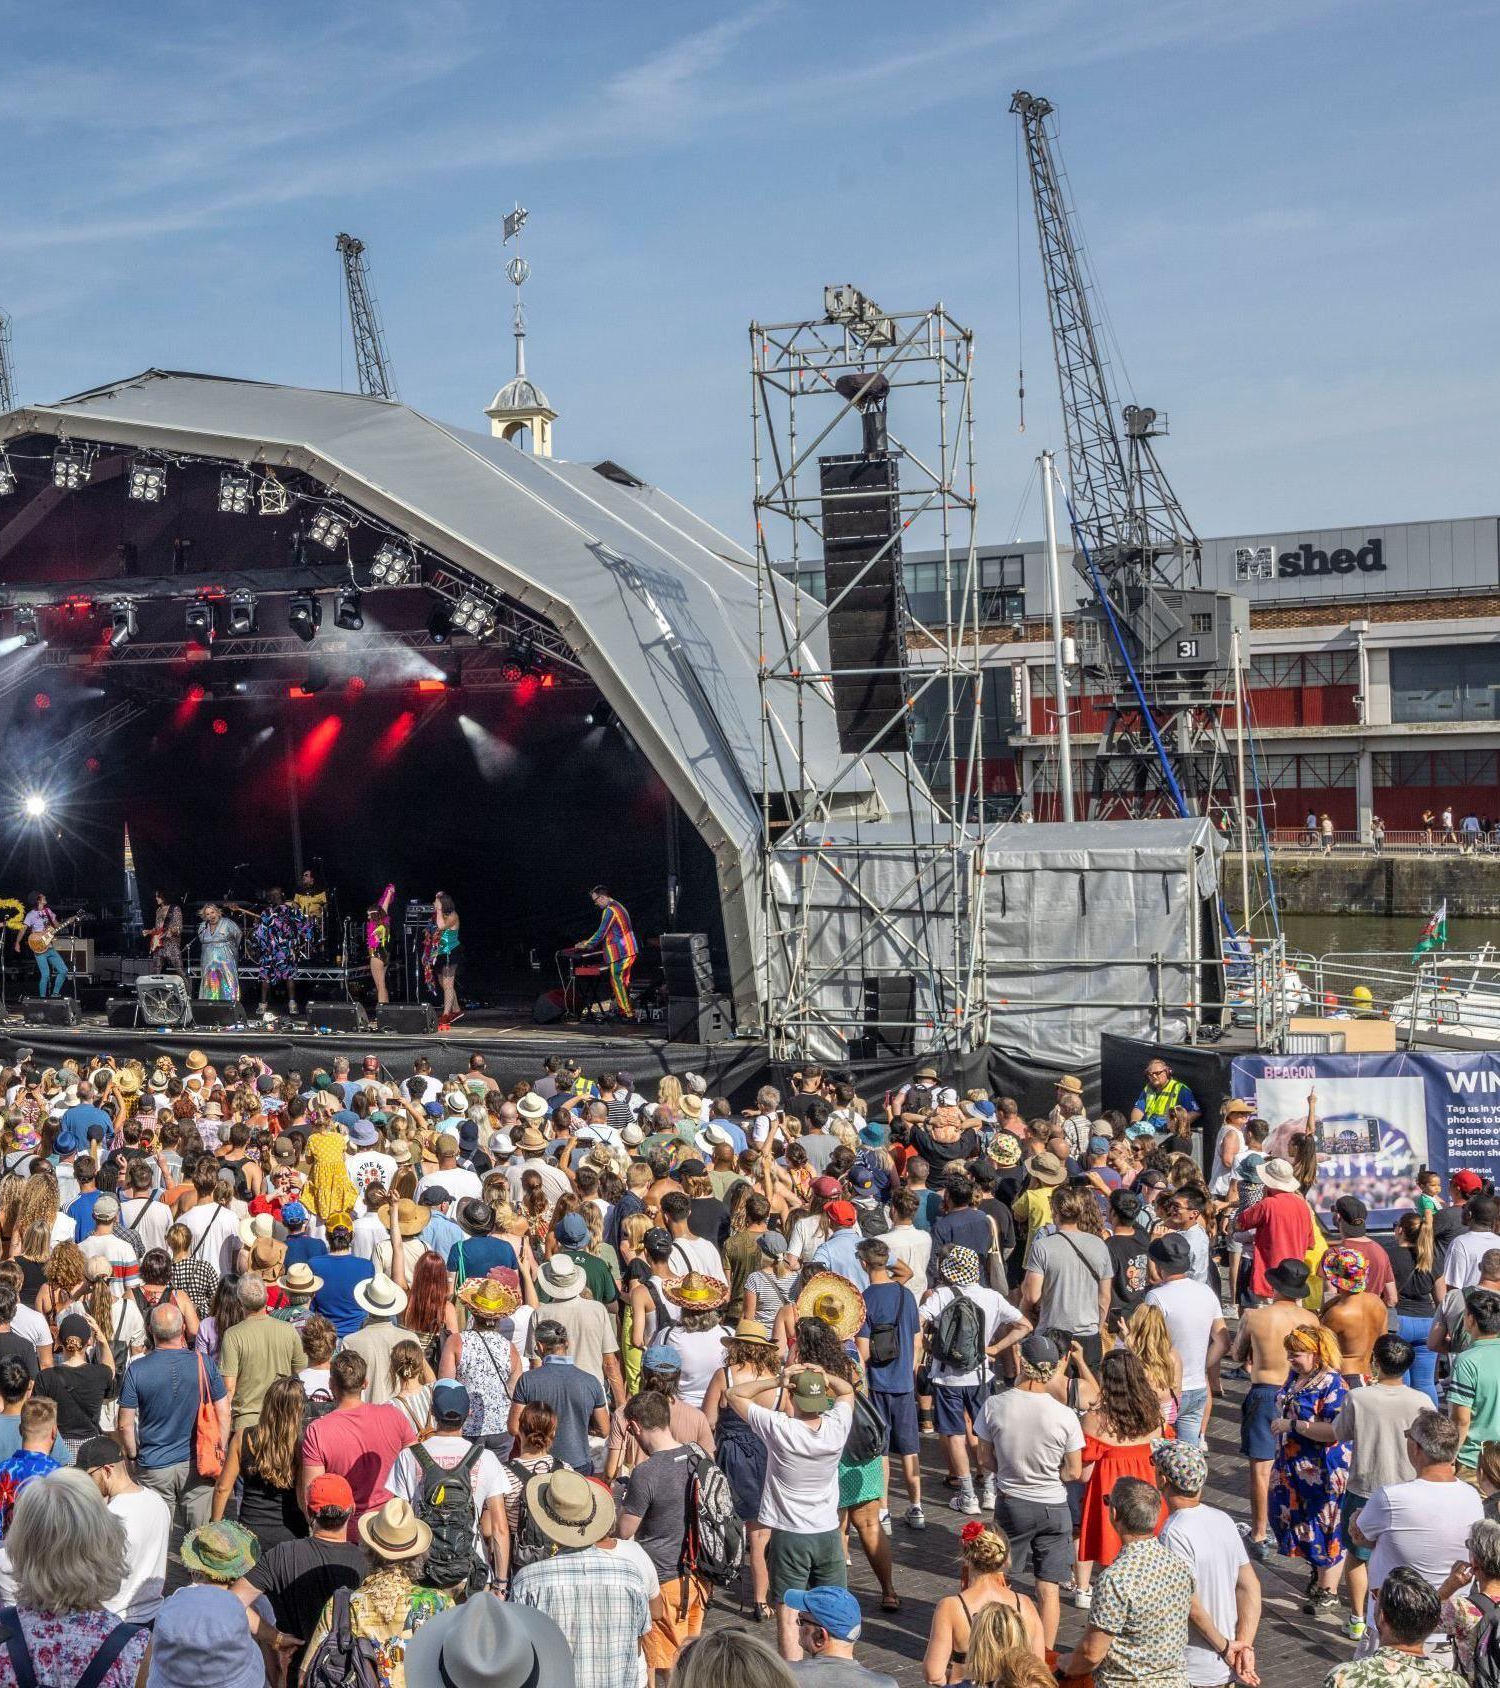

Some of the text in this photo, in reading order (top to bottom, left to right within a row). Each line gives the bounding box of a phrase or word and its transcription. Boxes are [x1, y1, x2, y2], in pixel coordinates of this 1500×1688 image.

[1278, 539, 1387, 577] shed
[1179, 641, 1197, 657] 31
[1264, 1066, 1316, 1079] BEACON
[1446, 1105, 1466, 1114] Tag
[1447, 1116, 1481, 1125] photos
[1448, 1138, 1464, 1147] gig
[360, 1161, 375, 1171] THE
